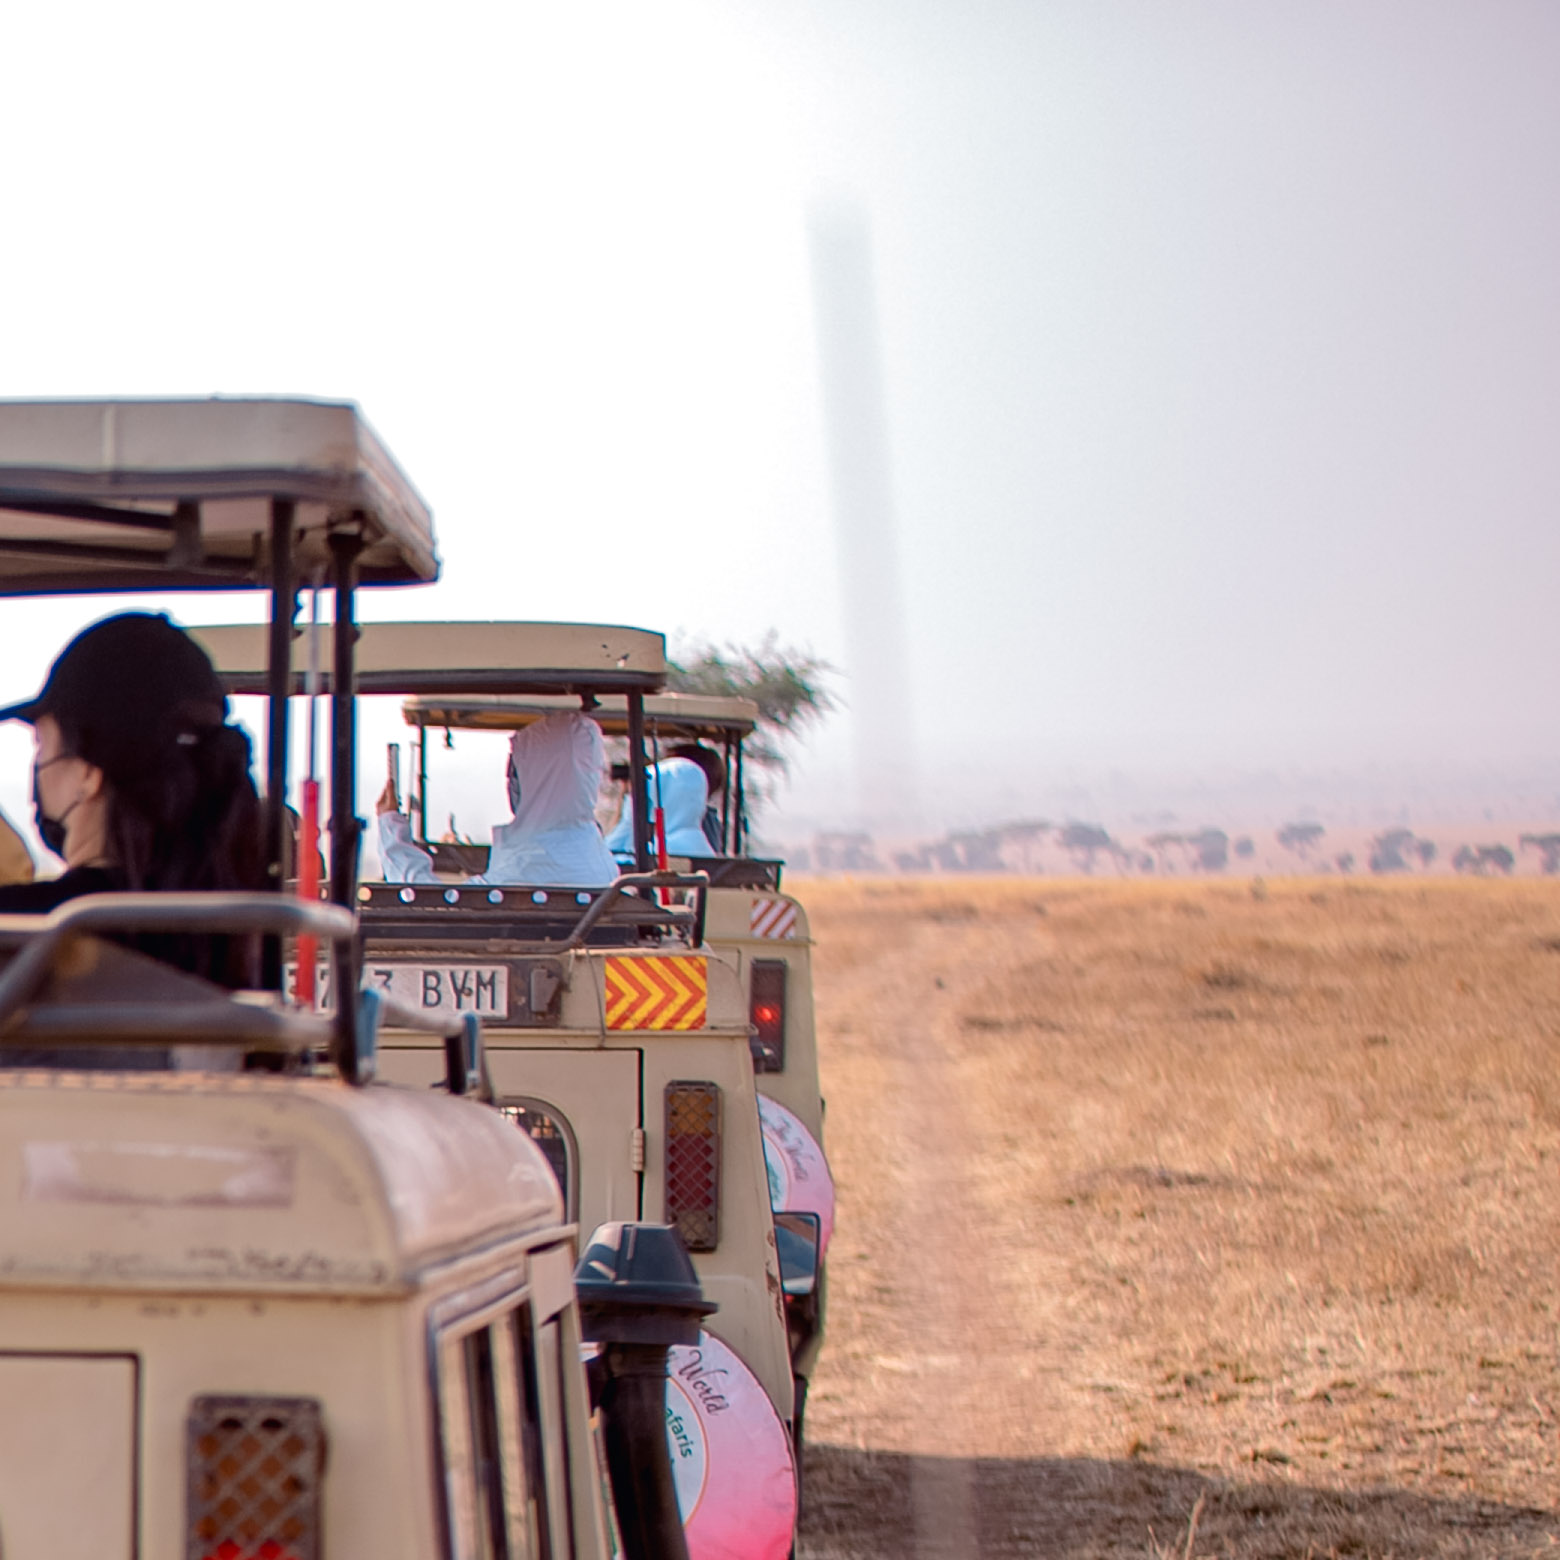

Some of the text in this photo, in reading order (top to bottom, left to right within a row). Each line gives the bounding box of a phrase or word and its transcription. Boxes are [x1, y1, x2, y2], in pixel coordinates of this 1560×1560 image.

[421, 969, 497, 1011] BYM
[678, 1349, 730, 1417] World
[665, 1406, 694, 1459] afaris
